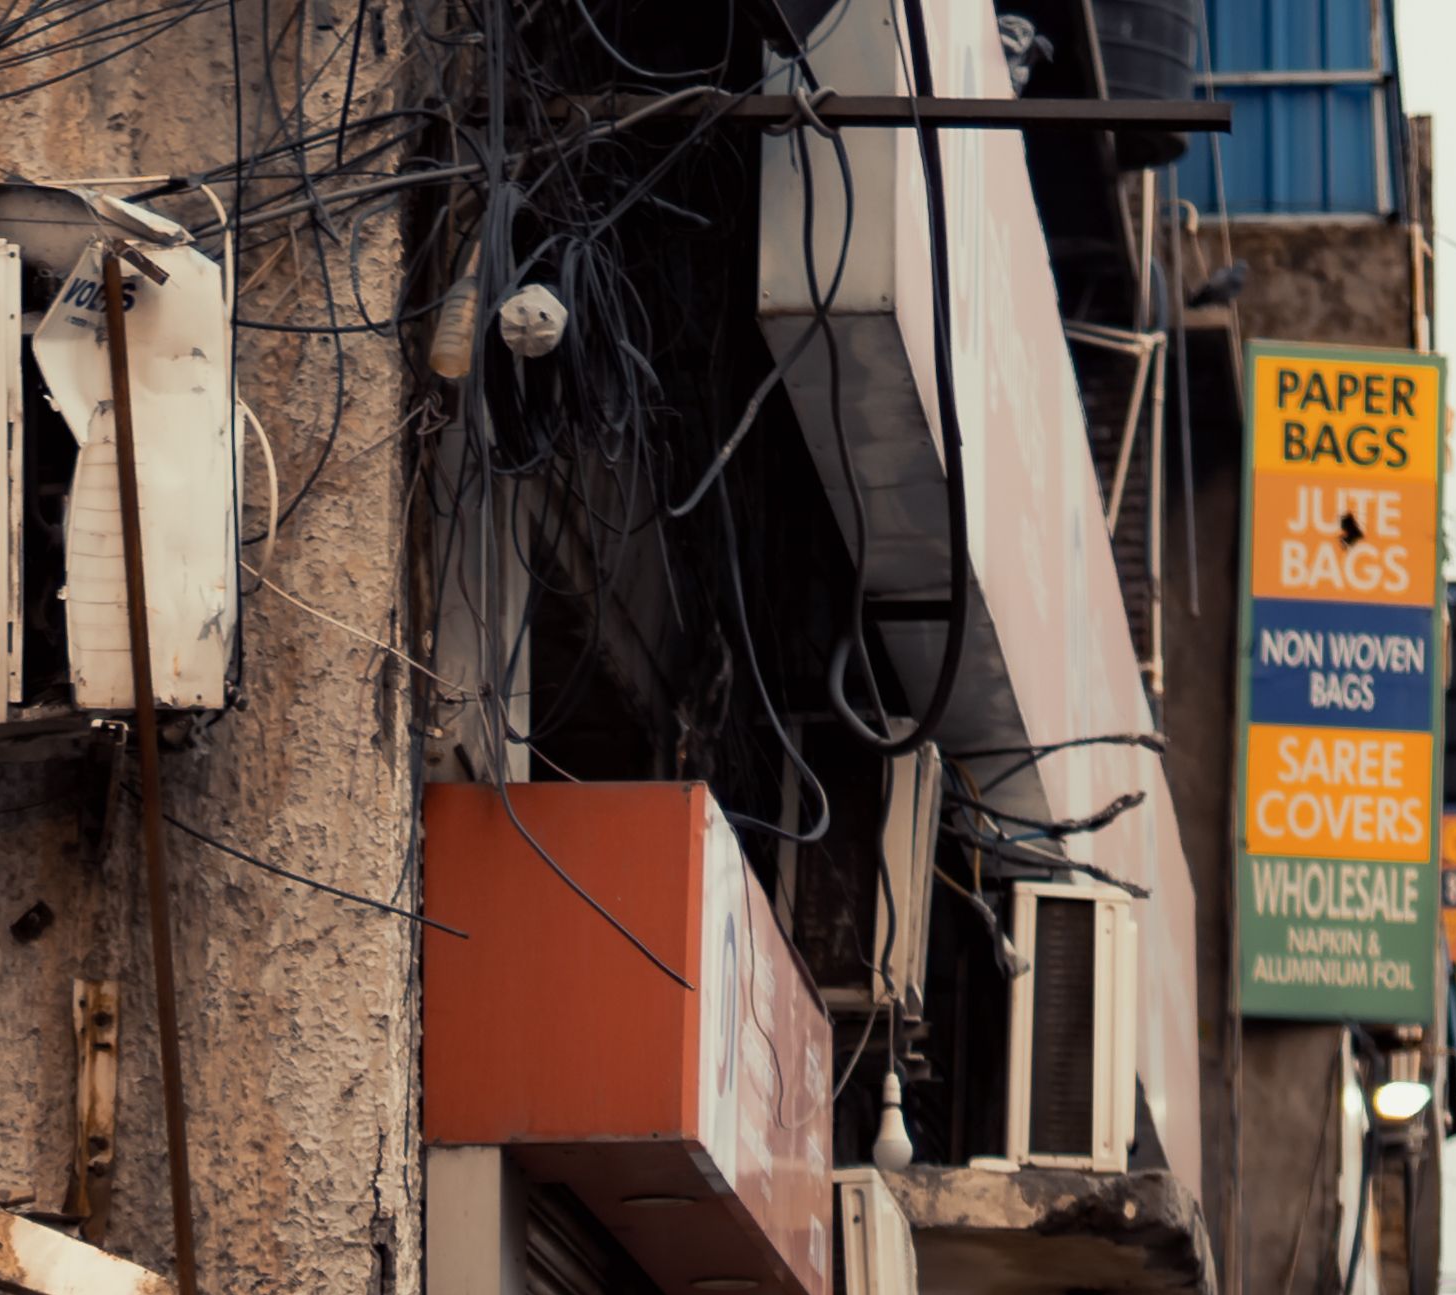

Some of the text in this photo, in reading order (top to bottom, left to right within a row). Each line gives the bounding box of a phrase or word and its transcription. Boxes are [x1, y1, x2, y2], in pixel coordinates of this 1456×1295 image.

[1277, 368, 1416, 418] PAPER
[1281, 420, 1409, 469] BAGS
[1288, 486, 1402, 538] JUTE
[1280, 540, 1410, 593] BAGS
[1261, 628, 1424, 674] NON WOVEN
[1310, 671, 1375, 711] BAGS
[1278, 735, 1404, 788] SAREE
[1255, 791, 1424, 845] COVERS
[1252, 861, 1419, 923] WHOLESALE
[1288, 926, 1382, 958] NAPKIN &
[1253, 954, 1414, 990] ALUMINIUM FOIL
